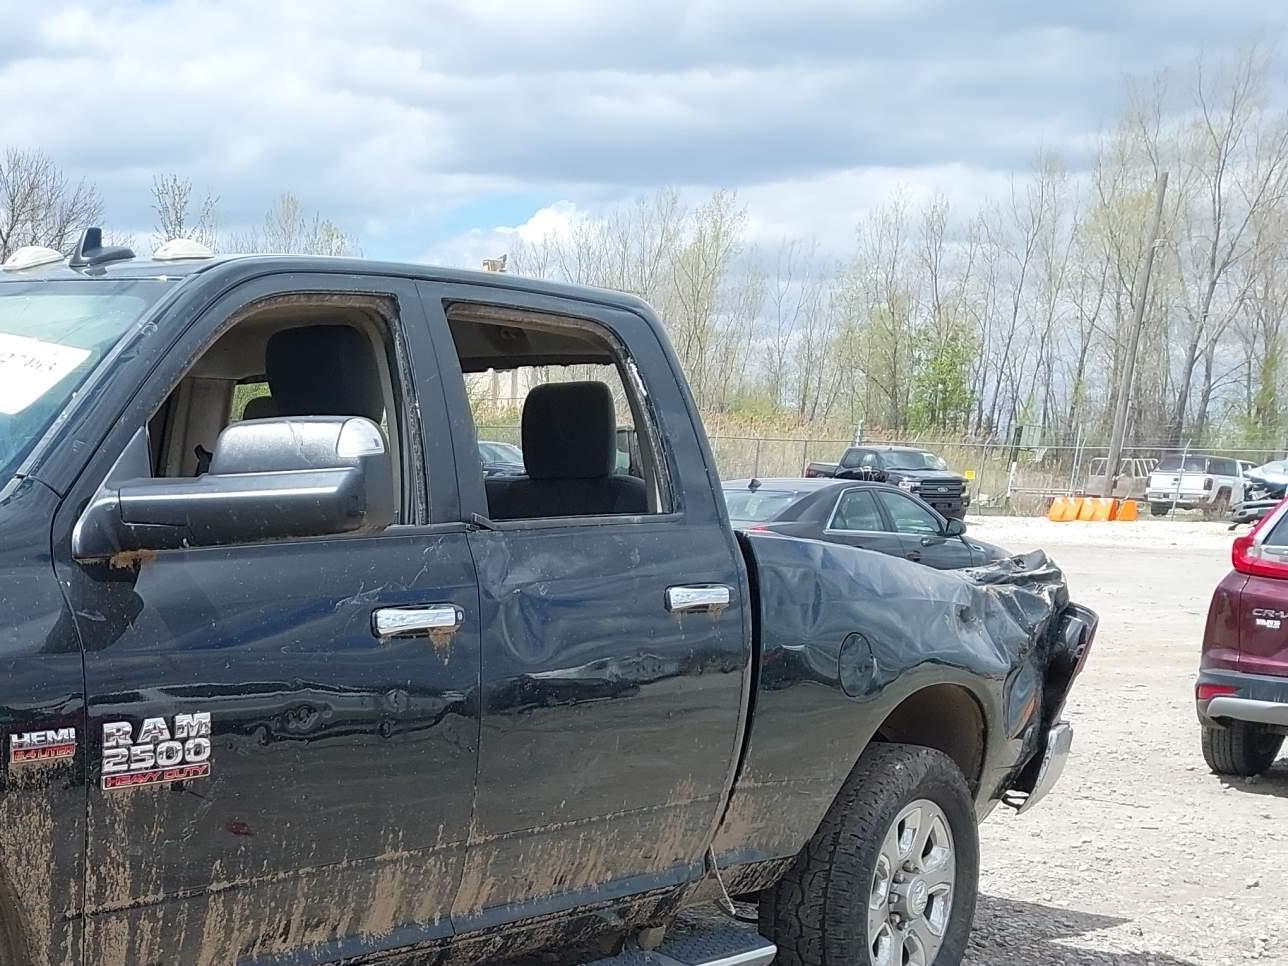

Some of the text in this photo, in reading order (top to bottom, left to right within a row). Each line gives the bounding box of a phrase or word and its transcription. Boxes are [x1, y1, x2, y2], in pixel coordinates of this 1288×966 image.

[9, 728, 76, 748] HEMI
[103, 712, 211, 748] RAM
[102, 738, 211, 774] 2500
[107, 765, 208, 788] HEAVY DUTY
